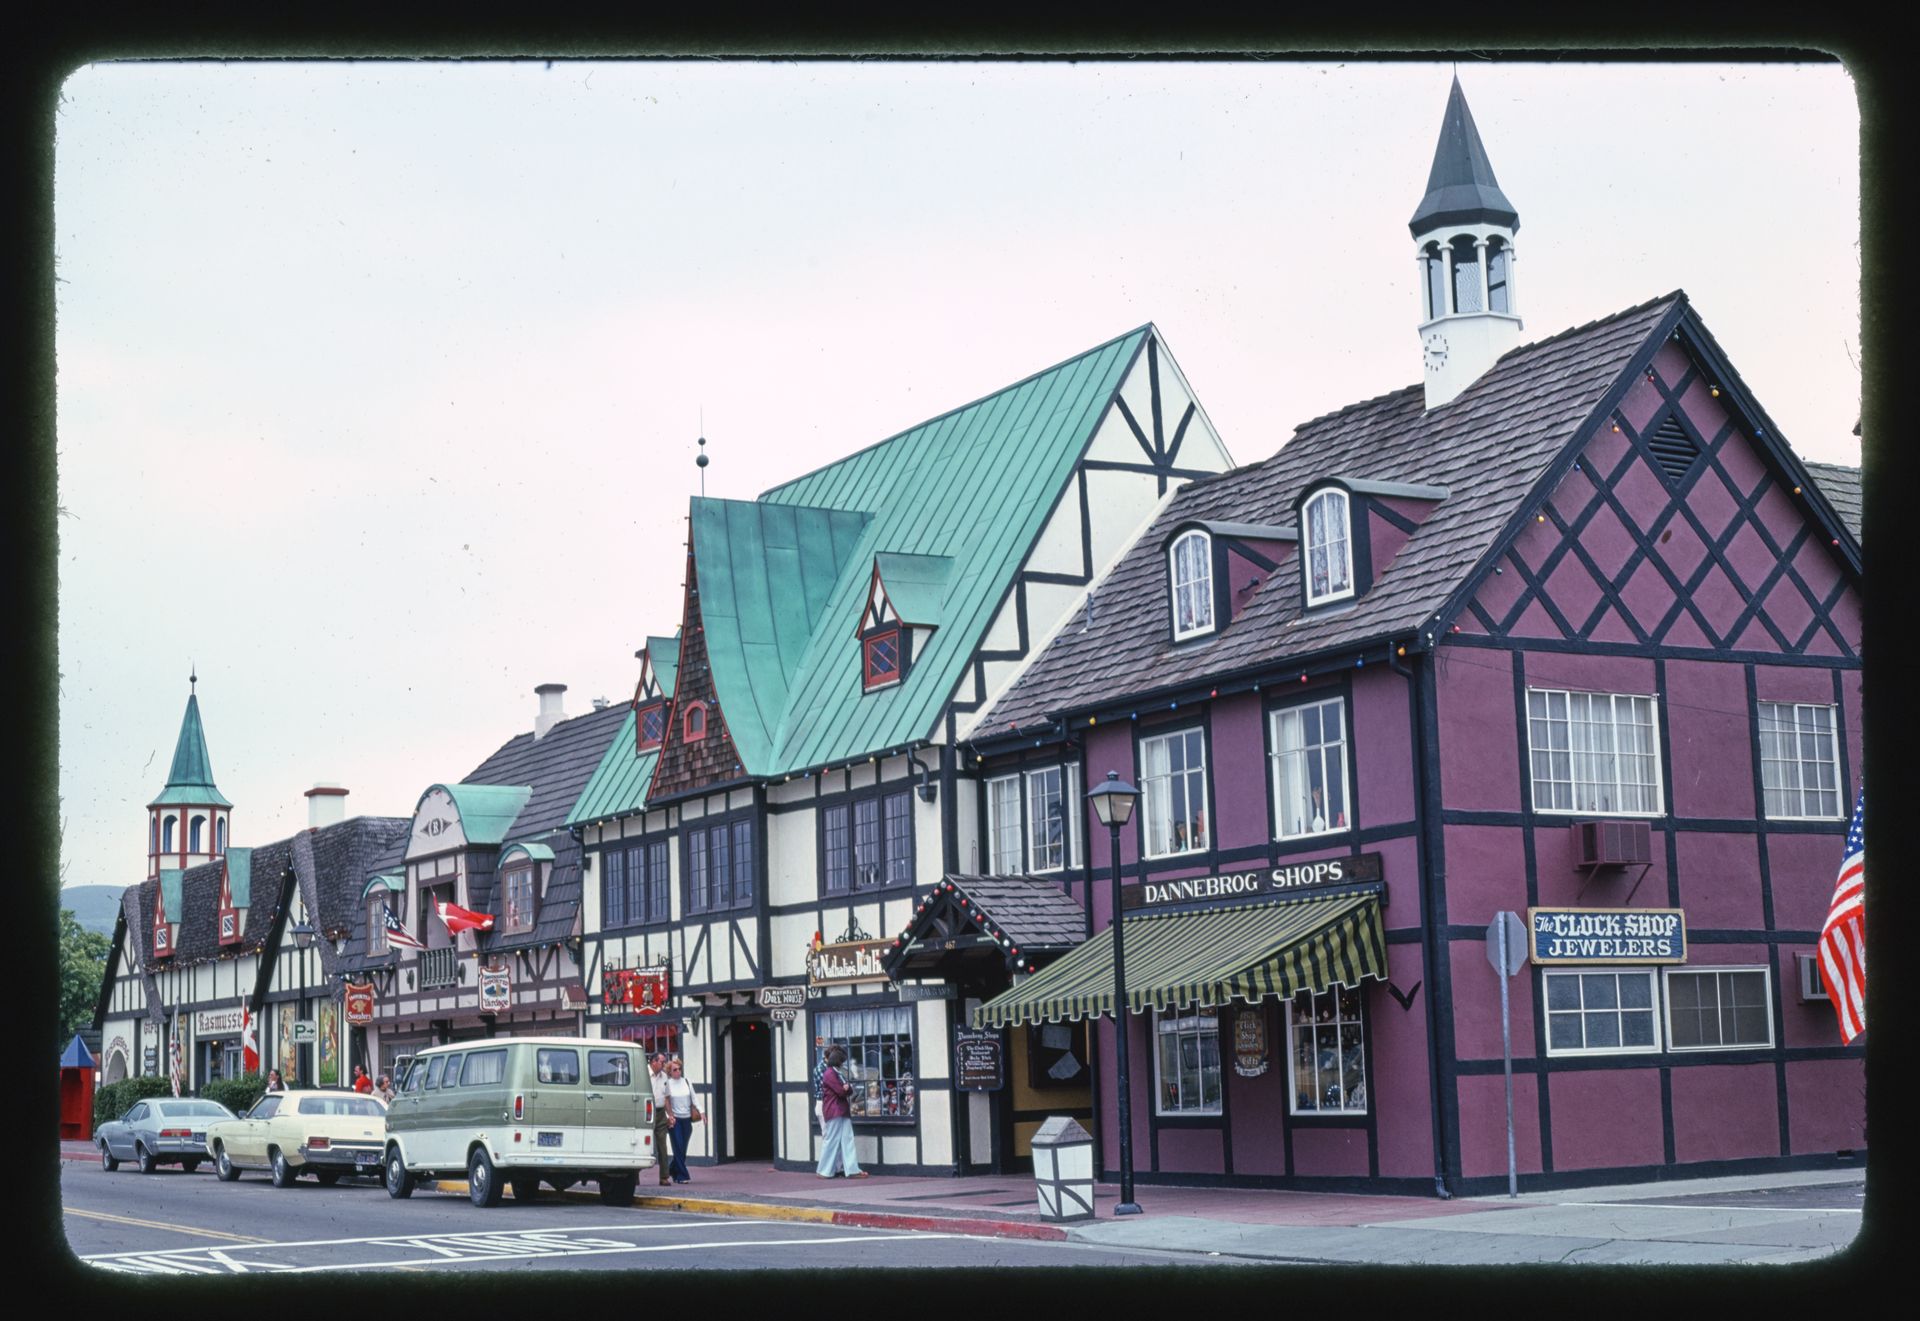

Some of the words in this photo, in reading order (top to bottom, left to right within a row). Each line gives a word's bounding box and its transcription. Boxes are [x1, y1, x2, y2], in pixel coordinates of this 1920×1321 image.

[1145, 874, 1258, 903] DANNEBROG
[1272, 861, 1343, 888] SHOPS
[1535, 916, 1554, 932] The
[1553, 914, 1622, 936] CLOCK
[1624, 914, 1678, 936] SHOP
[1549, 938, 1672, 956] JEWELERS
[776, 1010, 795, 1019] TOYS
